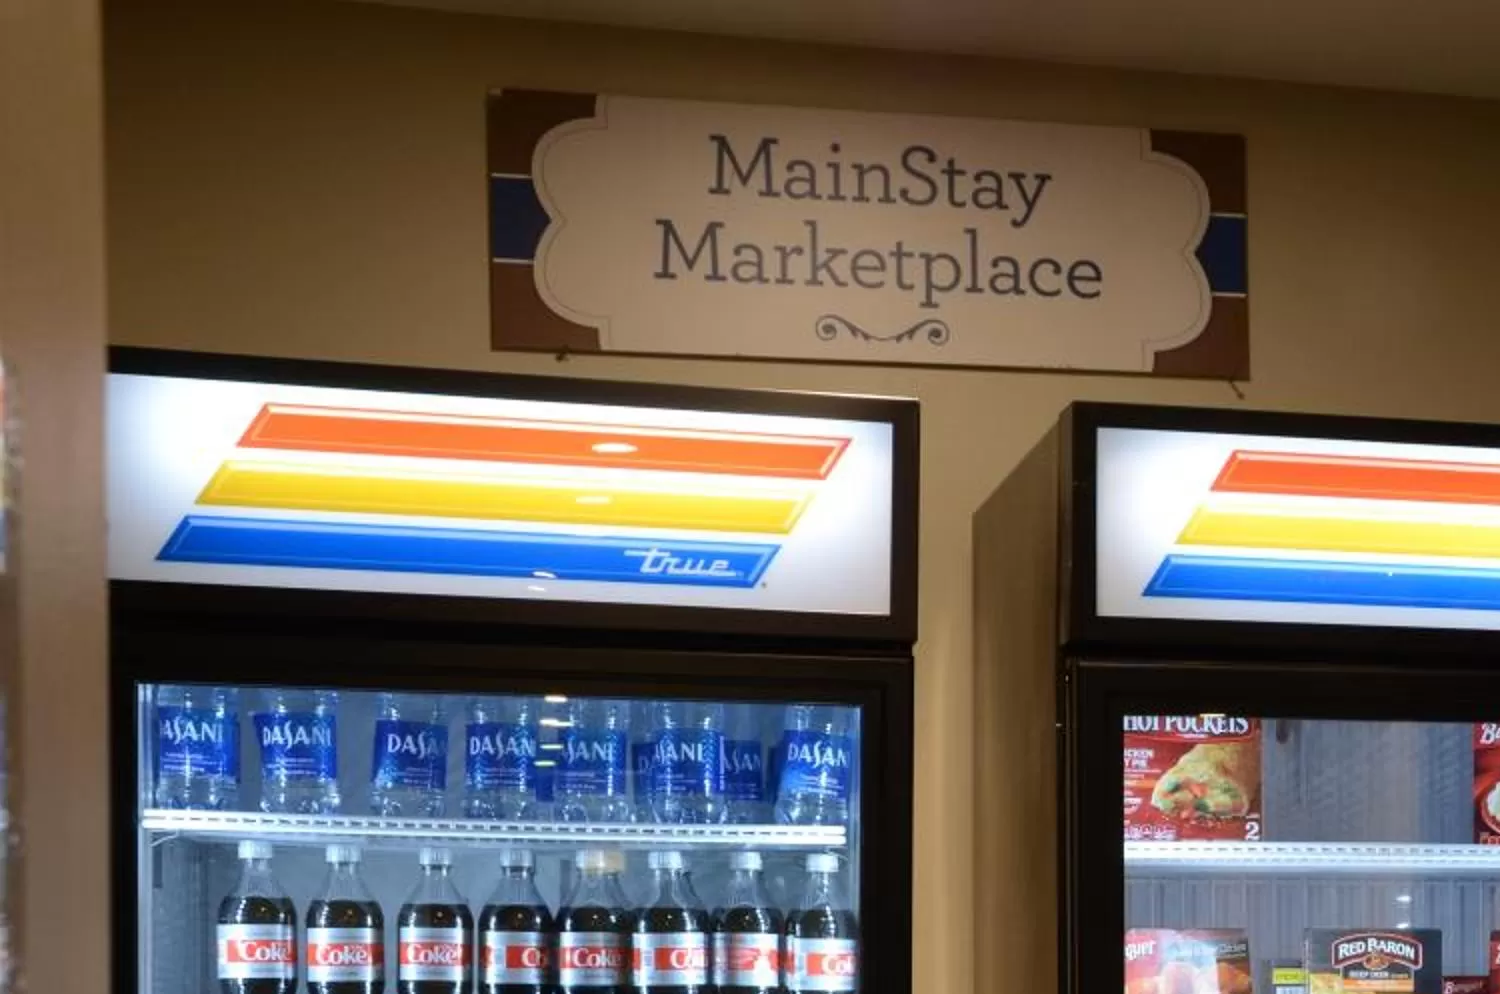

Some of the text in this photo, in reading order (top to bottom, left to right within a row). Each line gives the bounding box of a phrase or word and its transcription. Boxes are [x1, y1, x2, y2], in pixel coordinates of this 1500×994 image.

[707, 133, 1053, 227] MainStay
[652, 218, 1104, 309] Marketplace
[623, 547, 737, 578] true
[159, 717, 223, 744] ASANI
[262, 724, 333, 749] DASANI
[1244, 820, 1261, 841] 2
[1338, 937, 1415, 960] RED BARON
